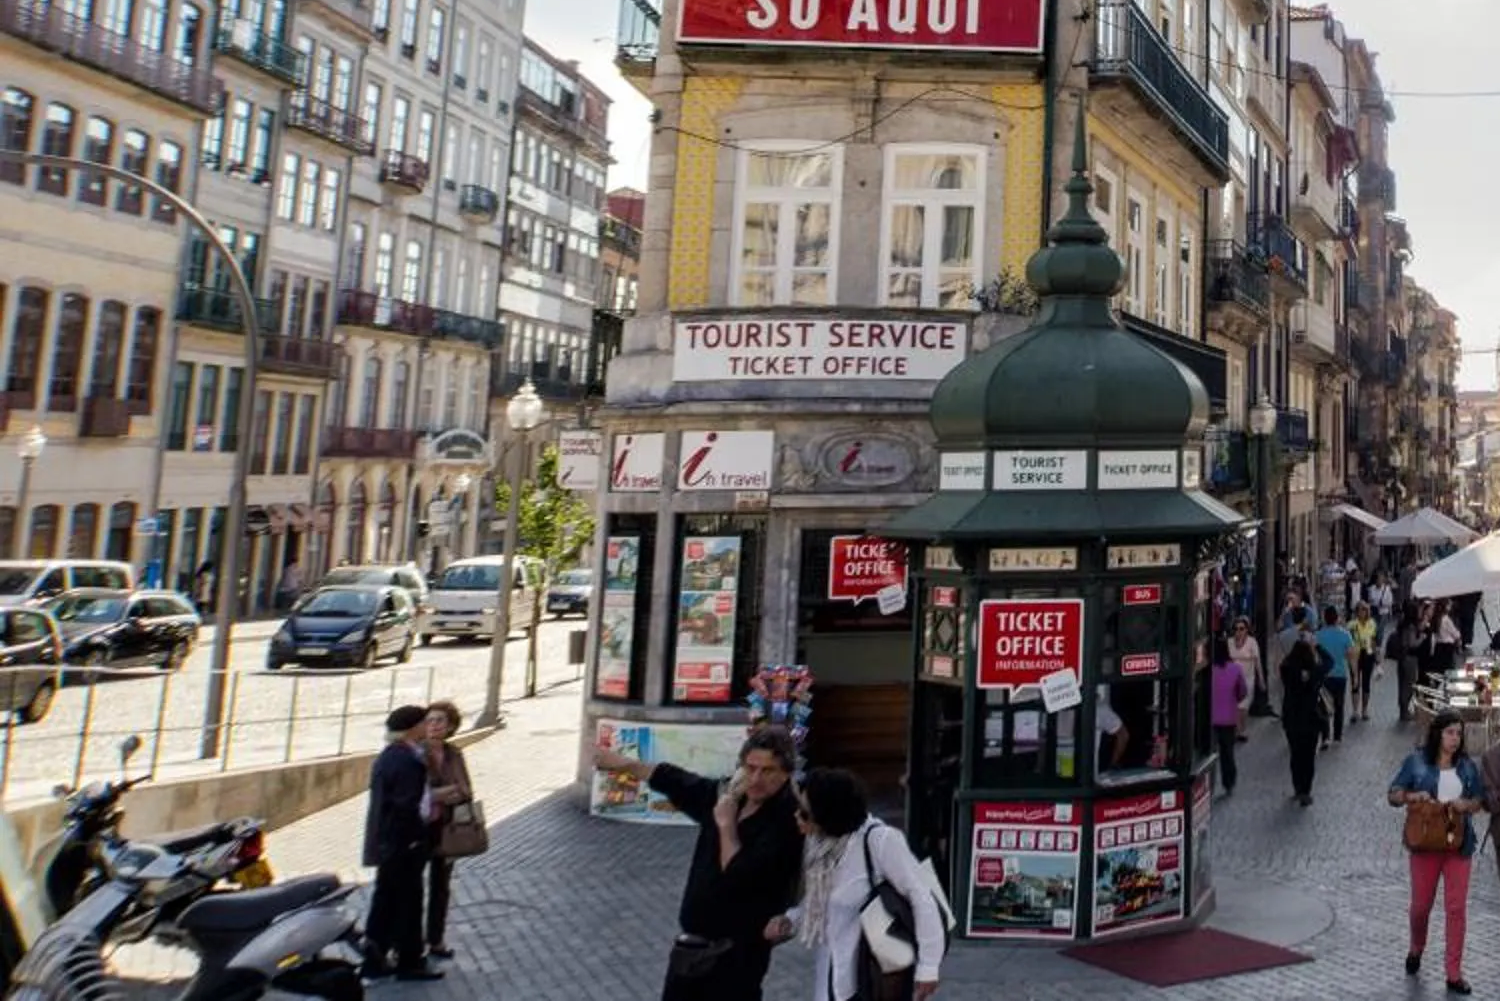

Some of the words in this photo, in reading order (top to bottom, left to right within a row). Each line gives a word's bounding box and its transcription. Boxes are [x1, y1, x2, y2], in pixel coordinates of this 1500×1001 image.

[685, 322, 816, 349] TOURIST
[828, 322, 956, 349] SERVICE
[728, 355, 815, 376] TICKET
[822, 355, 908, 376] OFFICE
[1011, 456, 1066, 469] TOURIST
[1104, 464, 1137, 476] TICKET
[1140, 463, 1173, 475] OFFICE
[721, 470, 768, 487] travel
[1011, 472, 1064, 485] SERVICE
[844, 542, 897, 559] TICKE
[843, 559, 897, 577] OFFICE
[996, 611, 1066, 632] TICKET
[995, 636, 1065, 656] OFFICE
[995, 658, 1065, 671] INFORMATION
